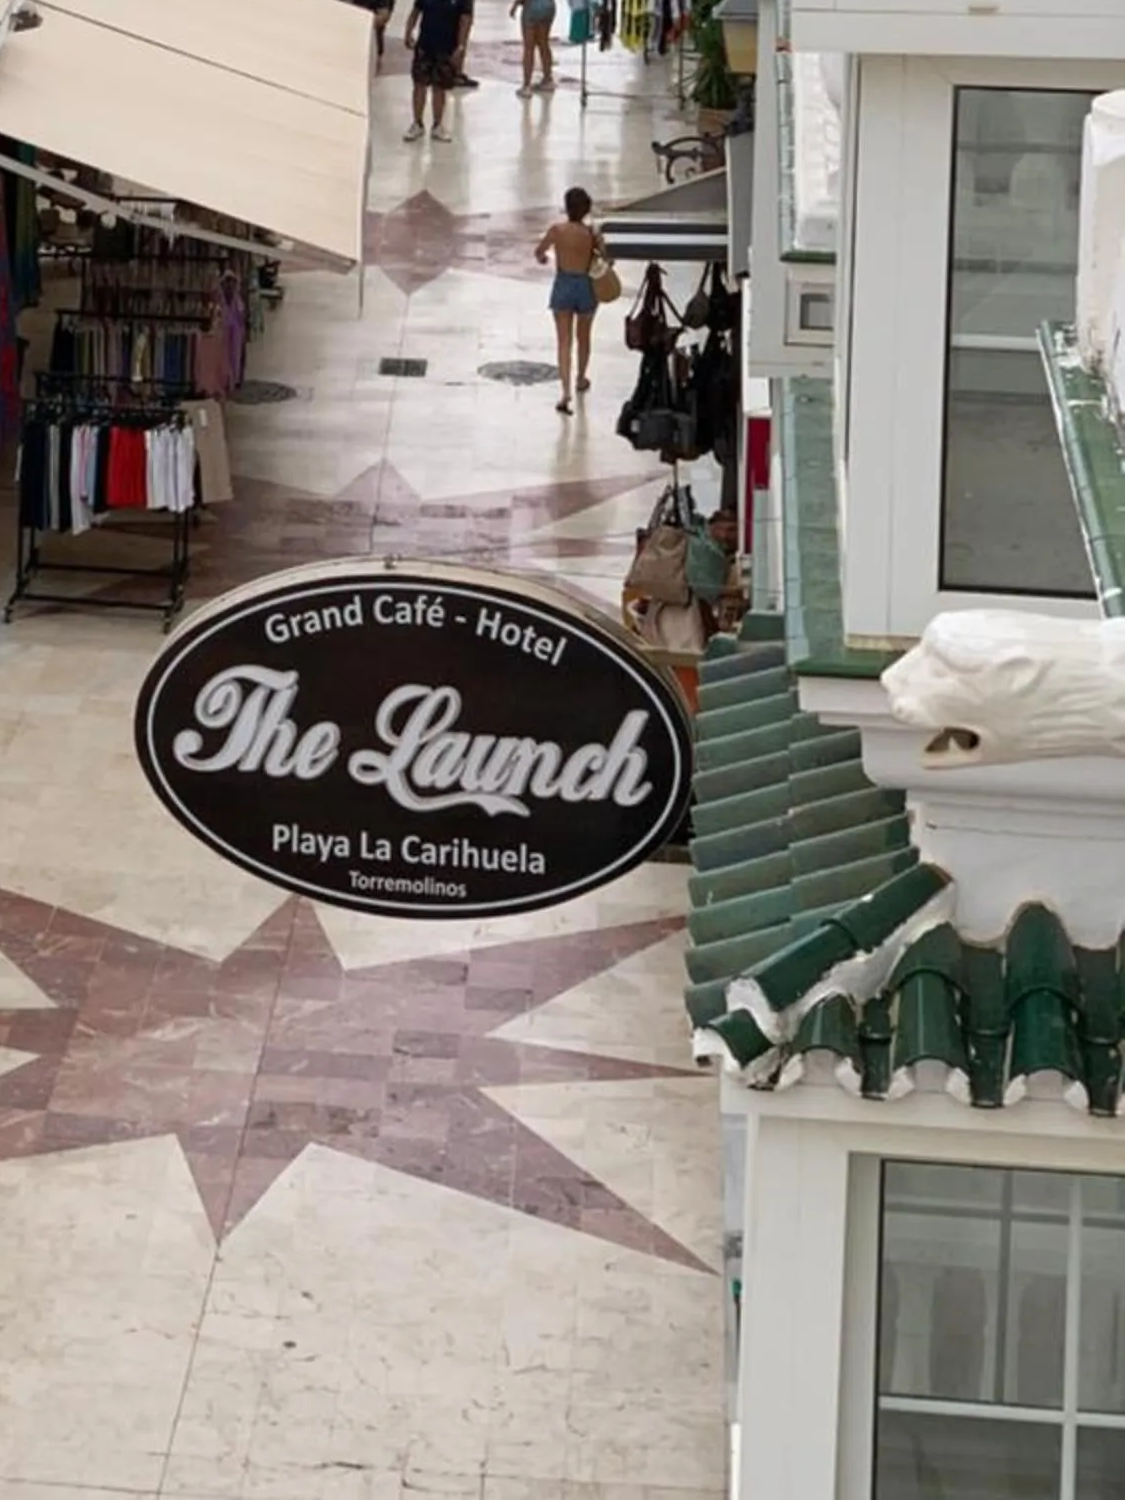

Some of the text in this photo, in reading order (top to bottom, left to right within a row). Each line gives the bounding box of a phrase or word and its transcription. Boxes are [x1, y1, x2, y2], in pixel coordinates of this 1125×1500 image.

[265, 596, 363, 644] Grand
[374, 589, 444, 628] Café
[476, 608, 567, 667] Hotel
[174, 664, 652, 818] The Launch
[272, 824, 546, 875] Playa La Carihuela
[348, 870, 467, 898] Torremolinos
